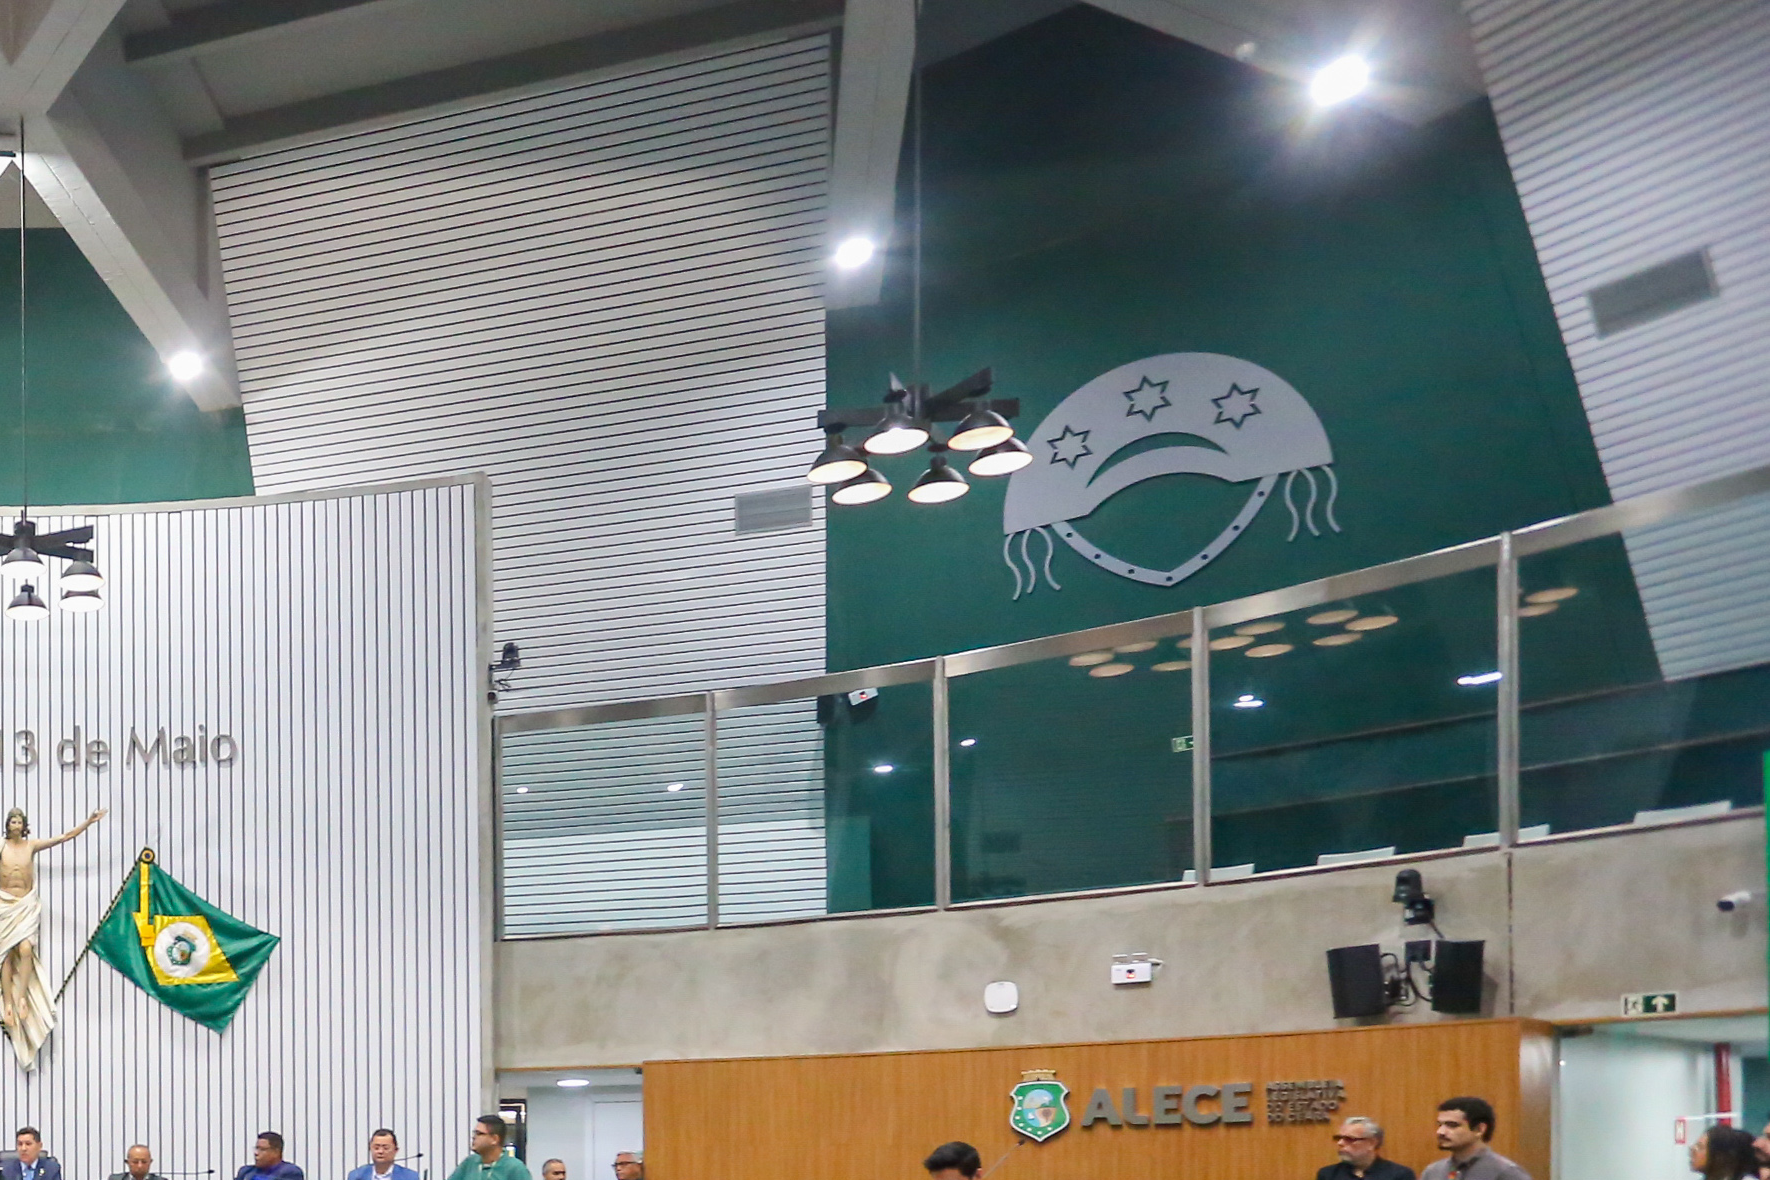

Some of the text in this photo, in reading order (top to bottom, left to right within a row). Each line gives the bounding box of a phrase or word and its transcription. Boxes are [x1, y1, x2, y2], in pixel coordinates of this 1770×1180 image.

[56, 725, 110, 768] de
[125, 724, 238, 769] Maio
[1081, 1082, 1253, 1128] ALECE
